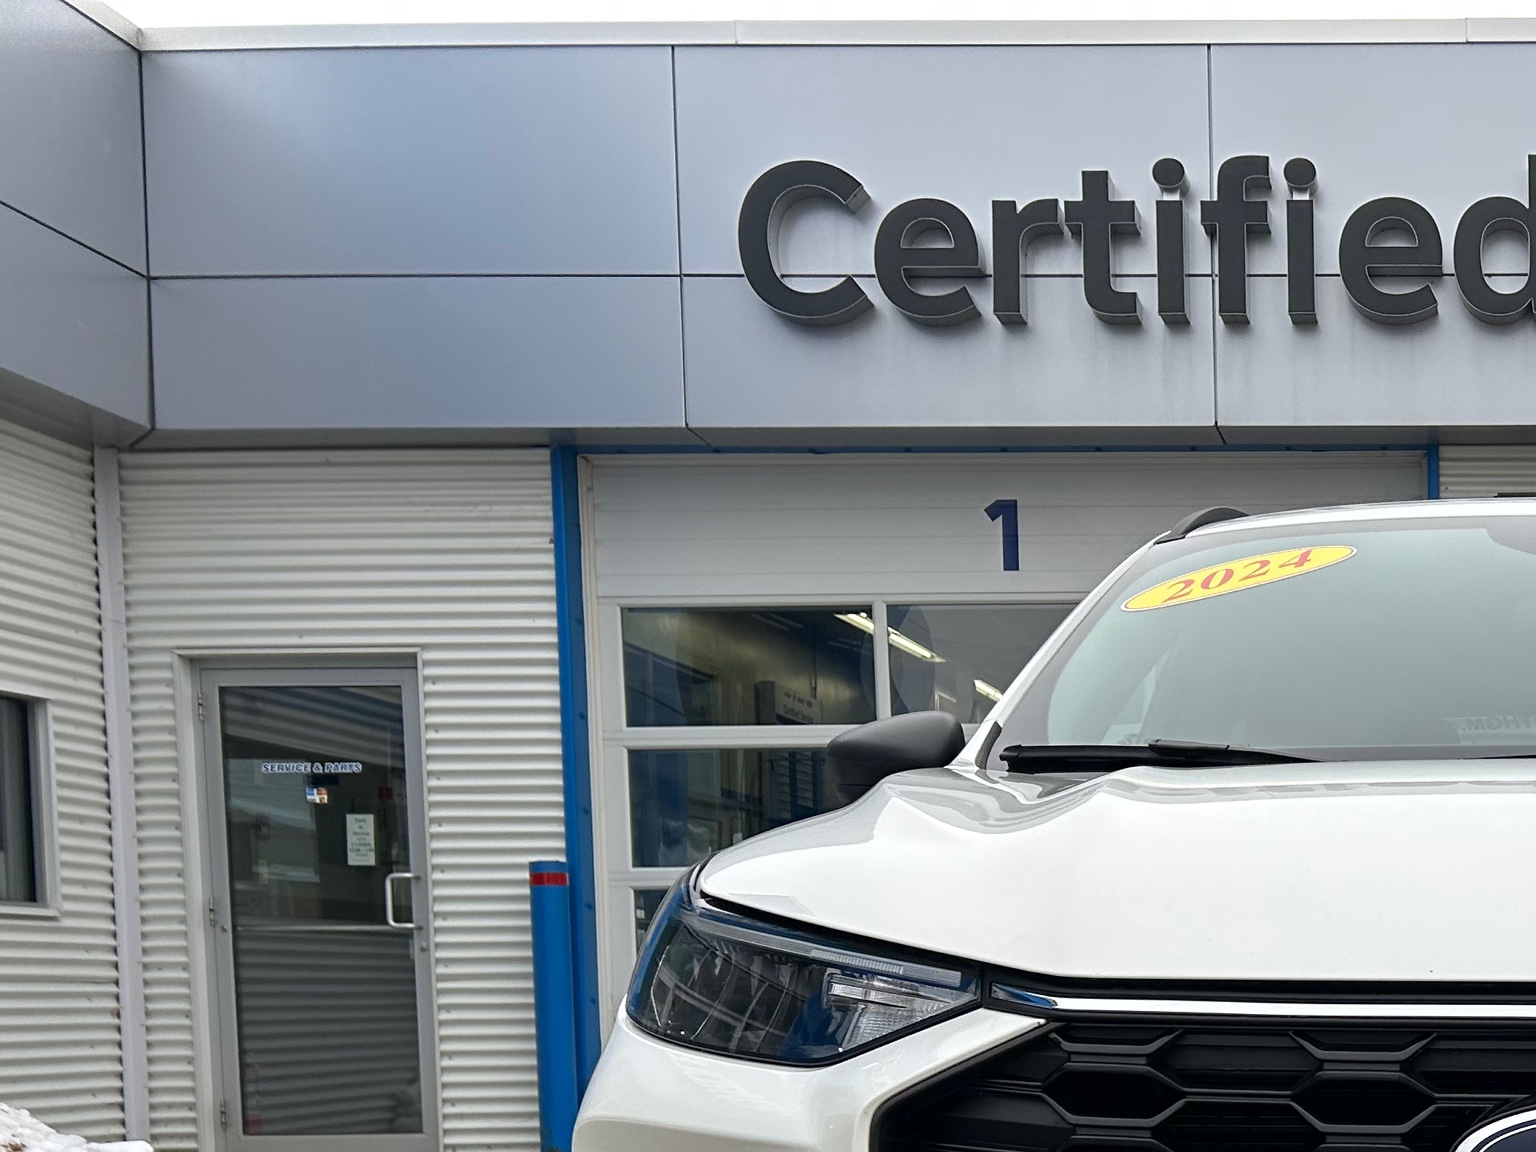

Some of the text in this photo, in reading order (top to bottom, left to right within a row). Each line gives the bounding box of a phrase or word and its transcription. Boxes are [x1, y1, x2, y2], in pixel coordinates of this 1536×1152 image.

[983, 499, 1020, 571] 1
[1160, 548, 1314, 605] 2024
[261, 762, 362, 773] SERVICE & PARTS
